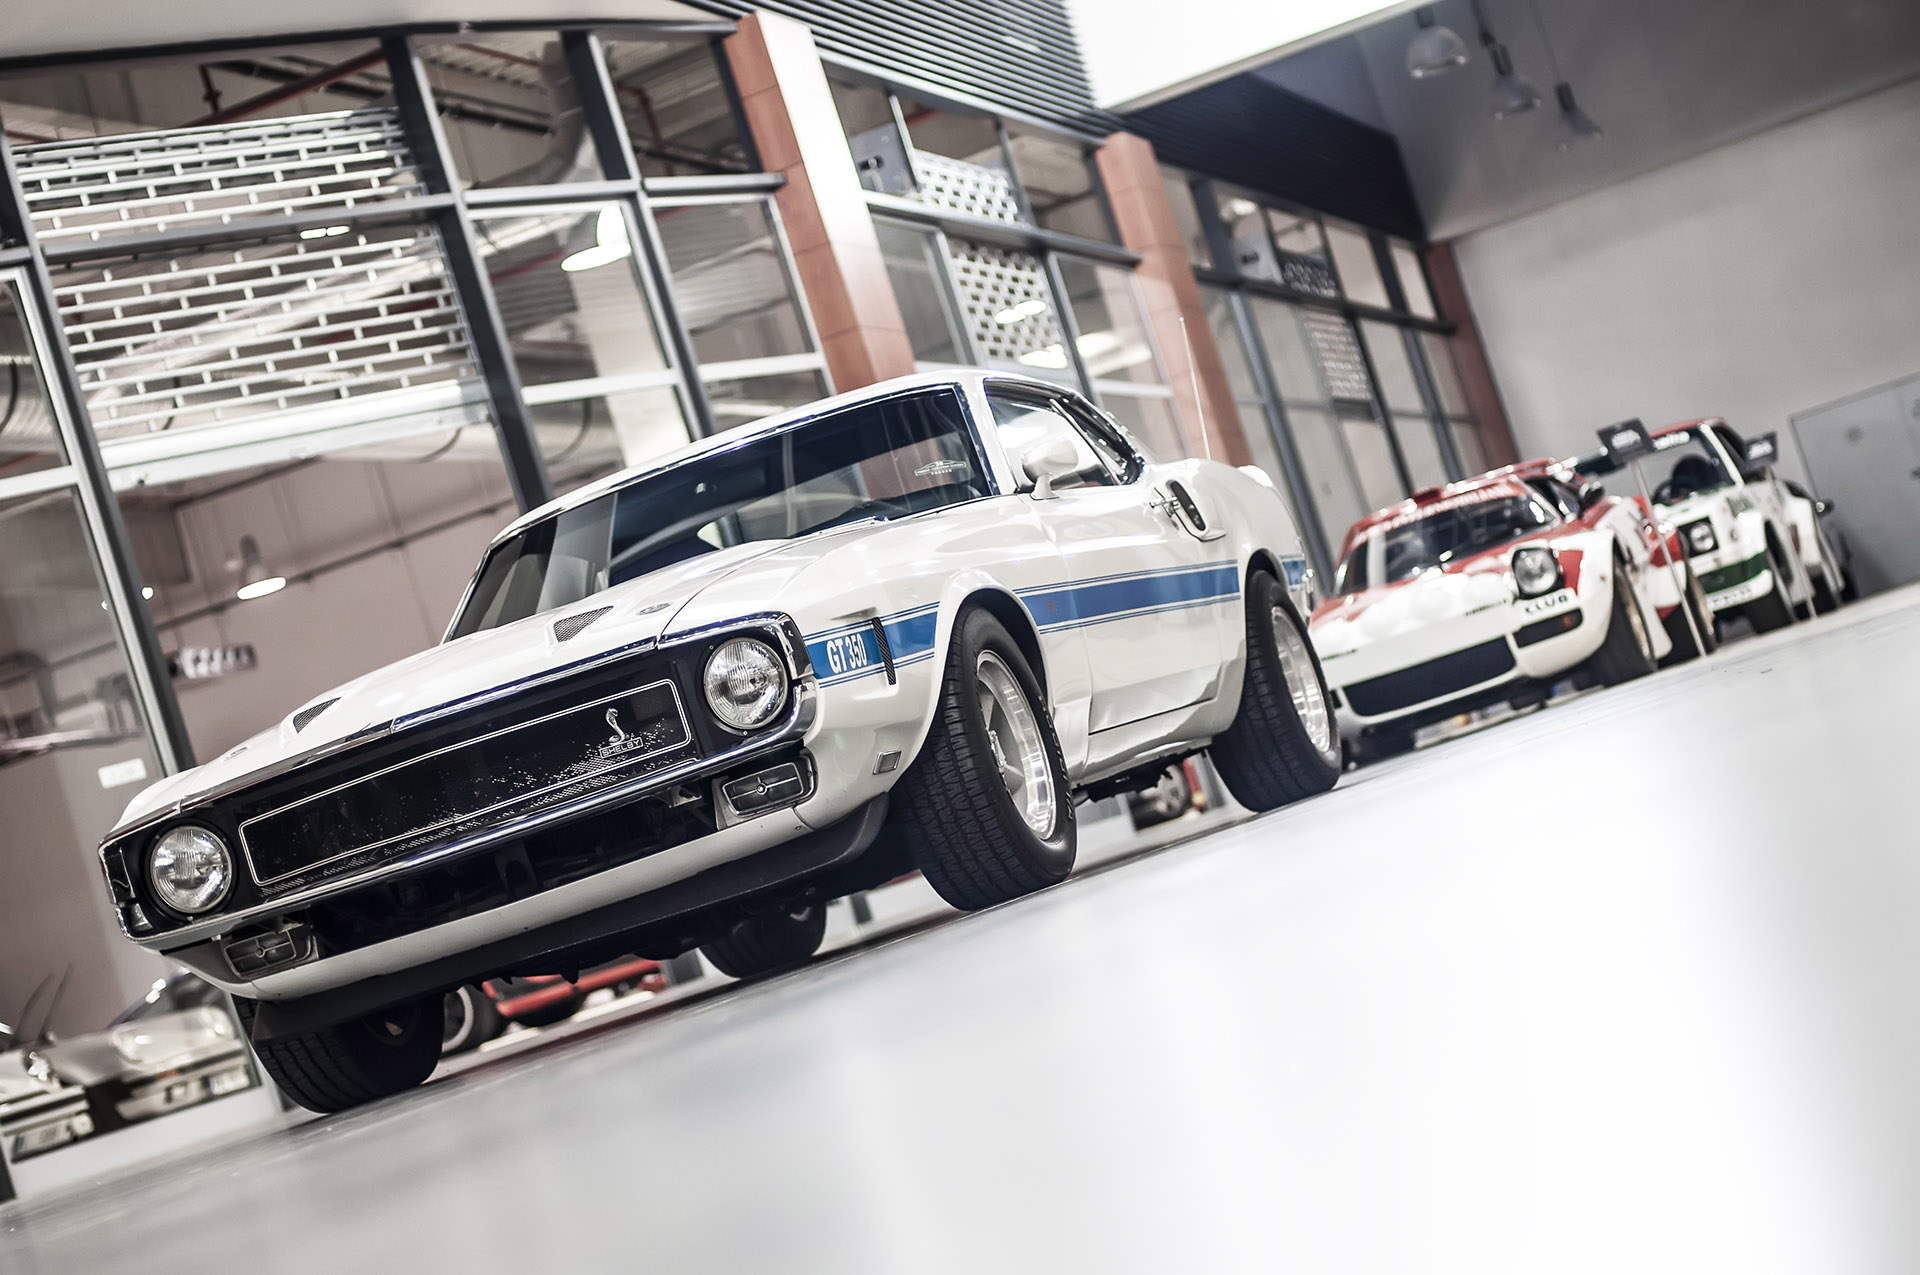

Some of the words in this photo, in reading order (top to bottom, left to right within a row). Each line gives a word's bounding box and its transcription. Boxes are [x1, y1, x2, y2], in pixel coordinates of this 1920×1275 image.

[826, 637, 848, 674] GT
[845, 633, 868, 669] 350
[601, 739, 640, 757] SHELBY
